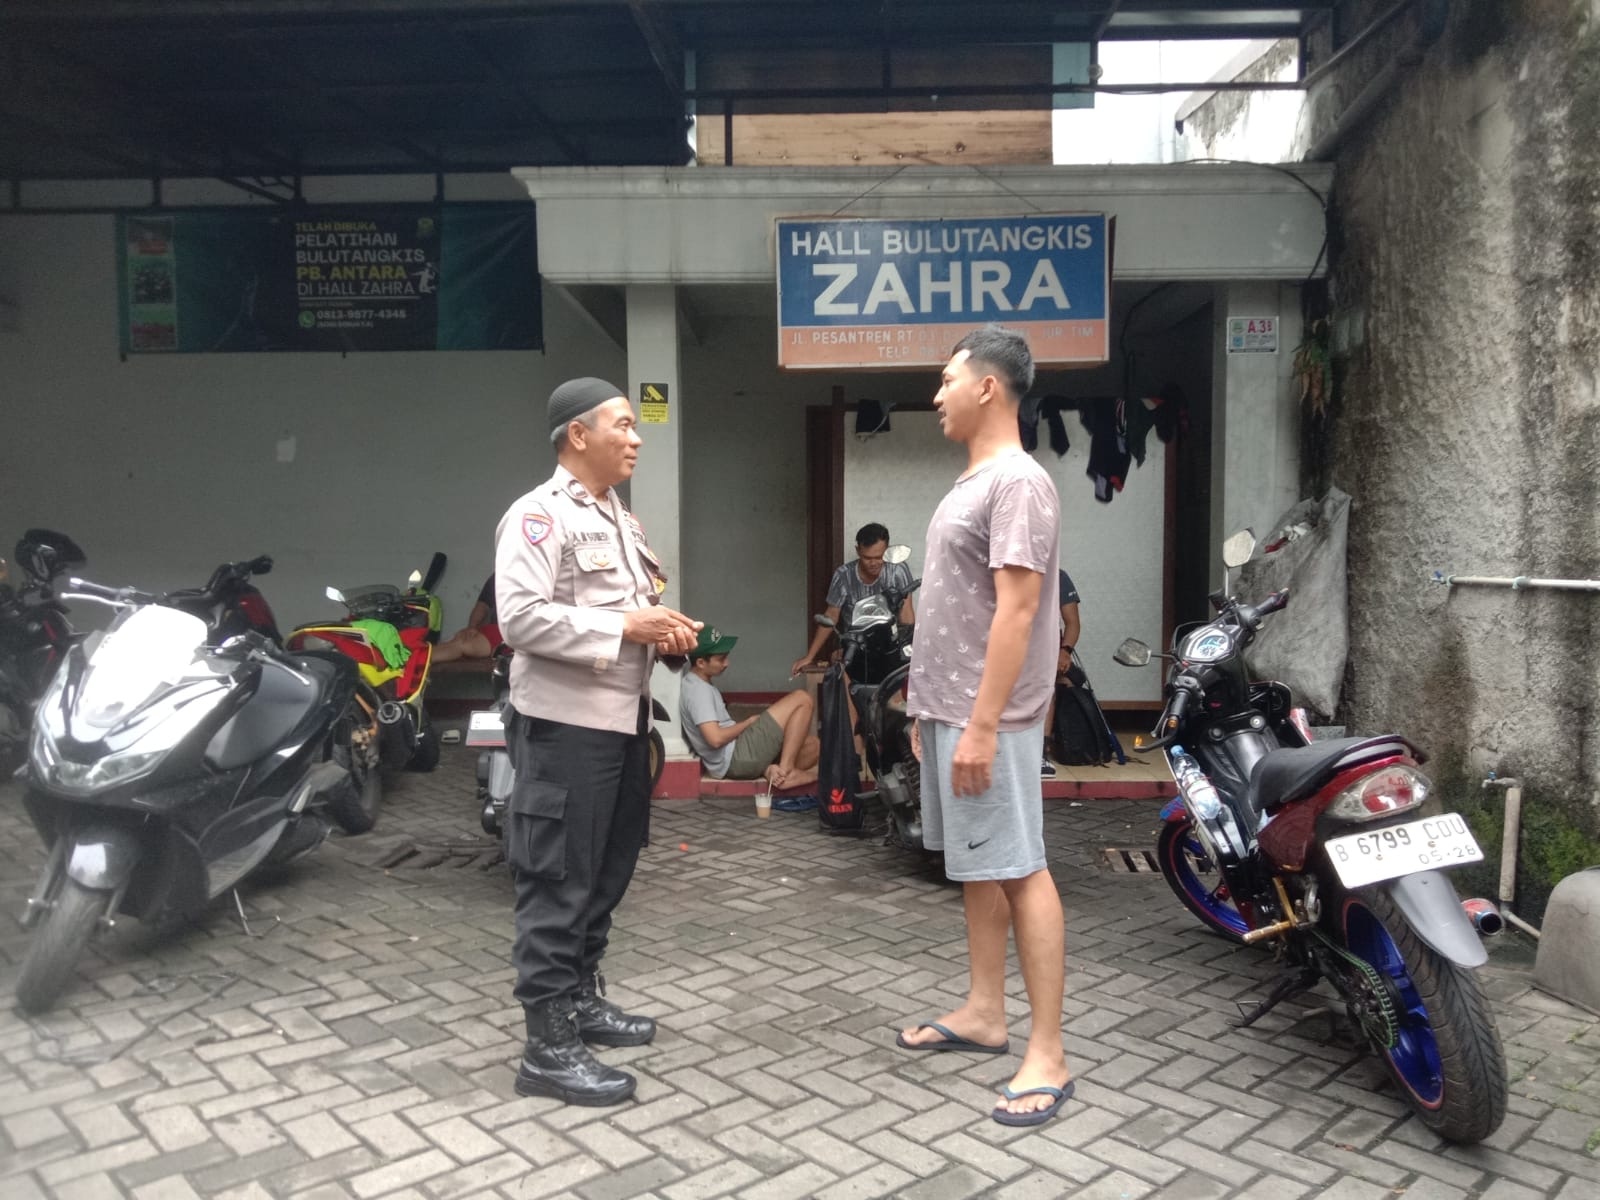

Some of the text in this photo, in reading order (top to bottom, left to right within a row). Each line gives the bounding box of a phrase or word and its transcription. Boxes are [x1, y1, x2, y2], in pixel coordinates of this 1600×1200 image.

[295, 233, 398, 247] PELATIHAN
[792, 223, 1093, 256] HALL BULUTANGKIS
[296, 248, 425, 264] BULUTANGKIS
[329, 265, 408, 280] ANTARA
[297, 280, 416, 295] DI HALL ZAHRA
[812, 258, 1072, 316] ZAHRA
[812, 330, 891, 345] PESANTREN
[897, 329, 913, 343] RT
[1335, 844, 1350, 862] B
[1356, 827, 1412, 856] 6799
